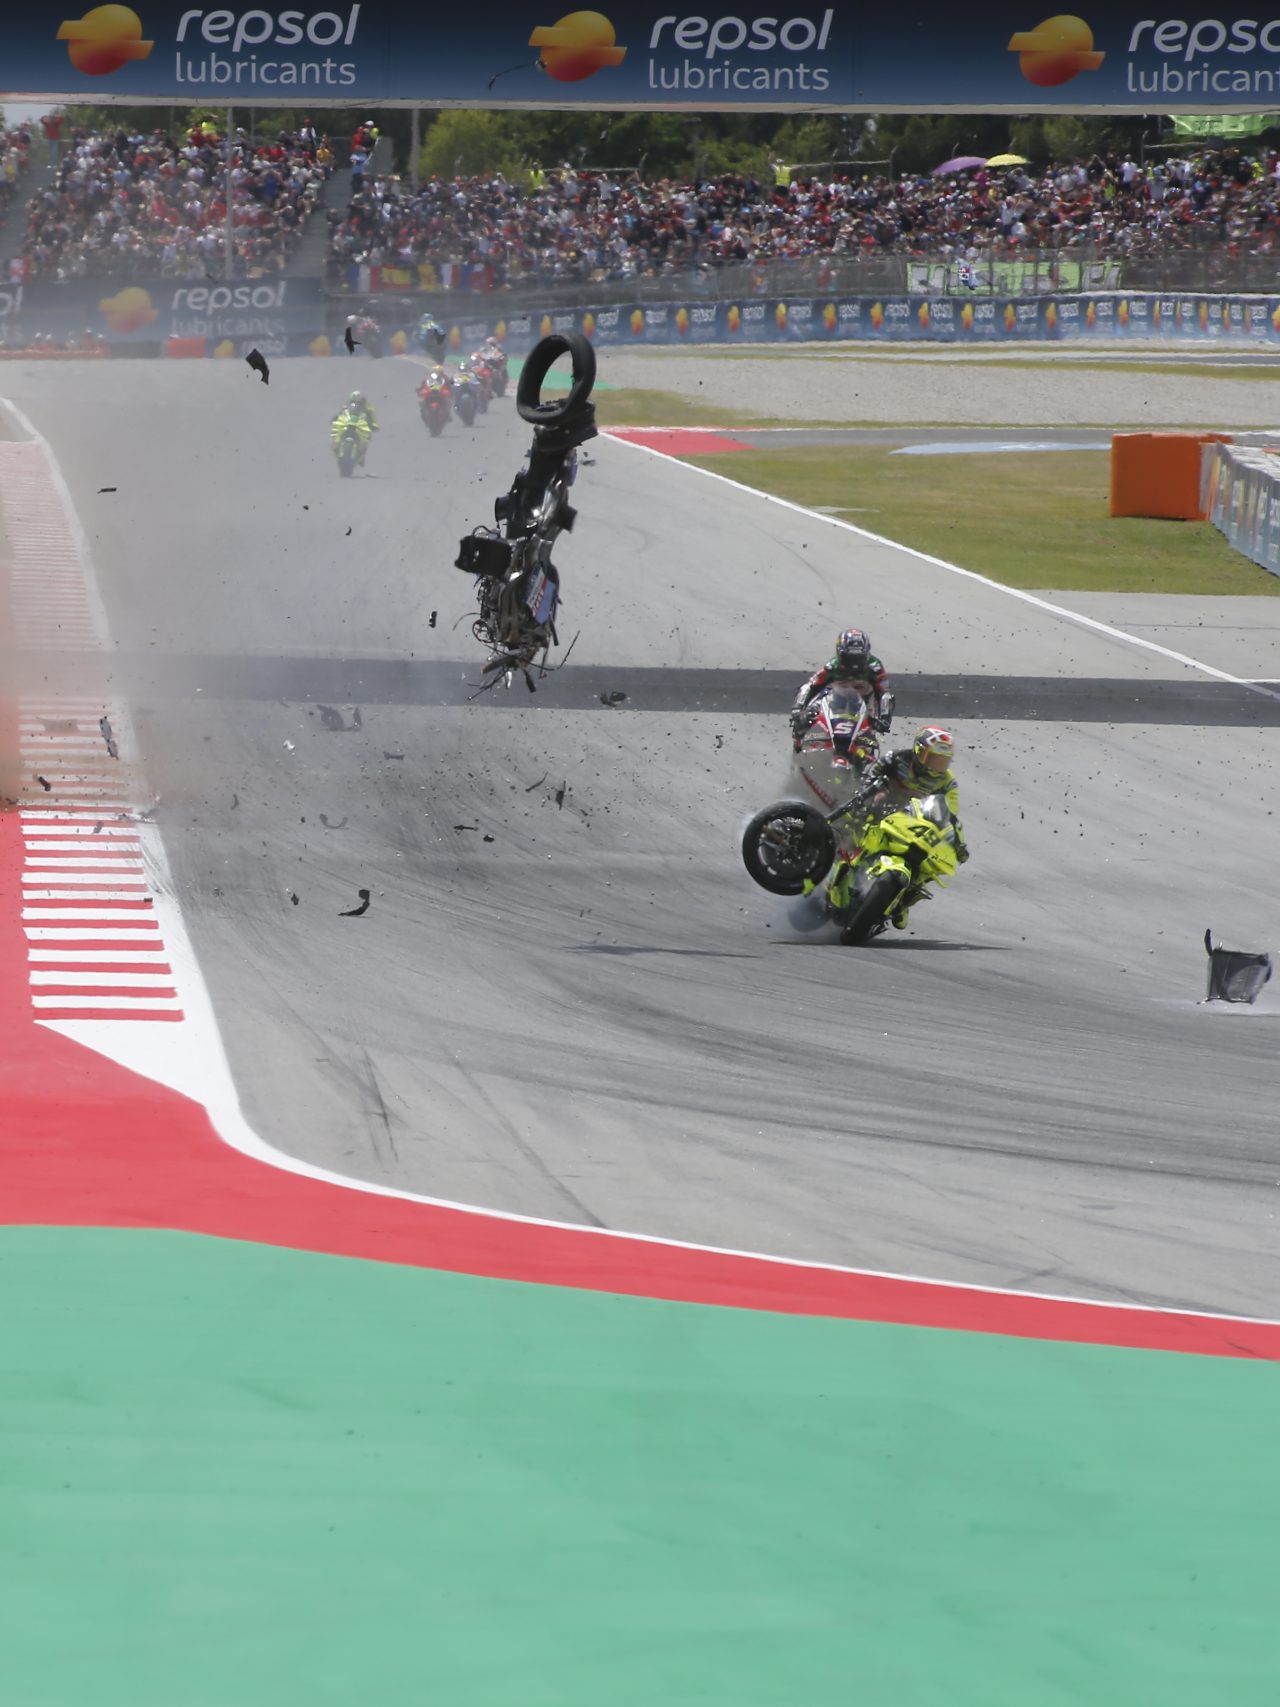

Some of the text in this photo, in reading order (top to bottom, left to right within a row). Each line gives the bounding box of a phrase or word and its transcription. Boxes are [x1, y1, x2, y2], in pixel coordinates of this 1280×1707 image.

[176, 4, 360, 52] repsol
[649, 9, 834, 59] repsol
[1128, 19, 1280, 61] repso
[175, 52, 356, 85] lubricants
[648, 58, 830, 91] lubricants
[1127, 62, 1280, 92] lubrican
[172, 280, 287, 315] repsol
